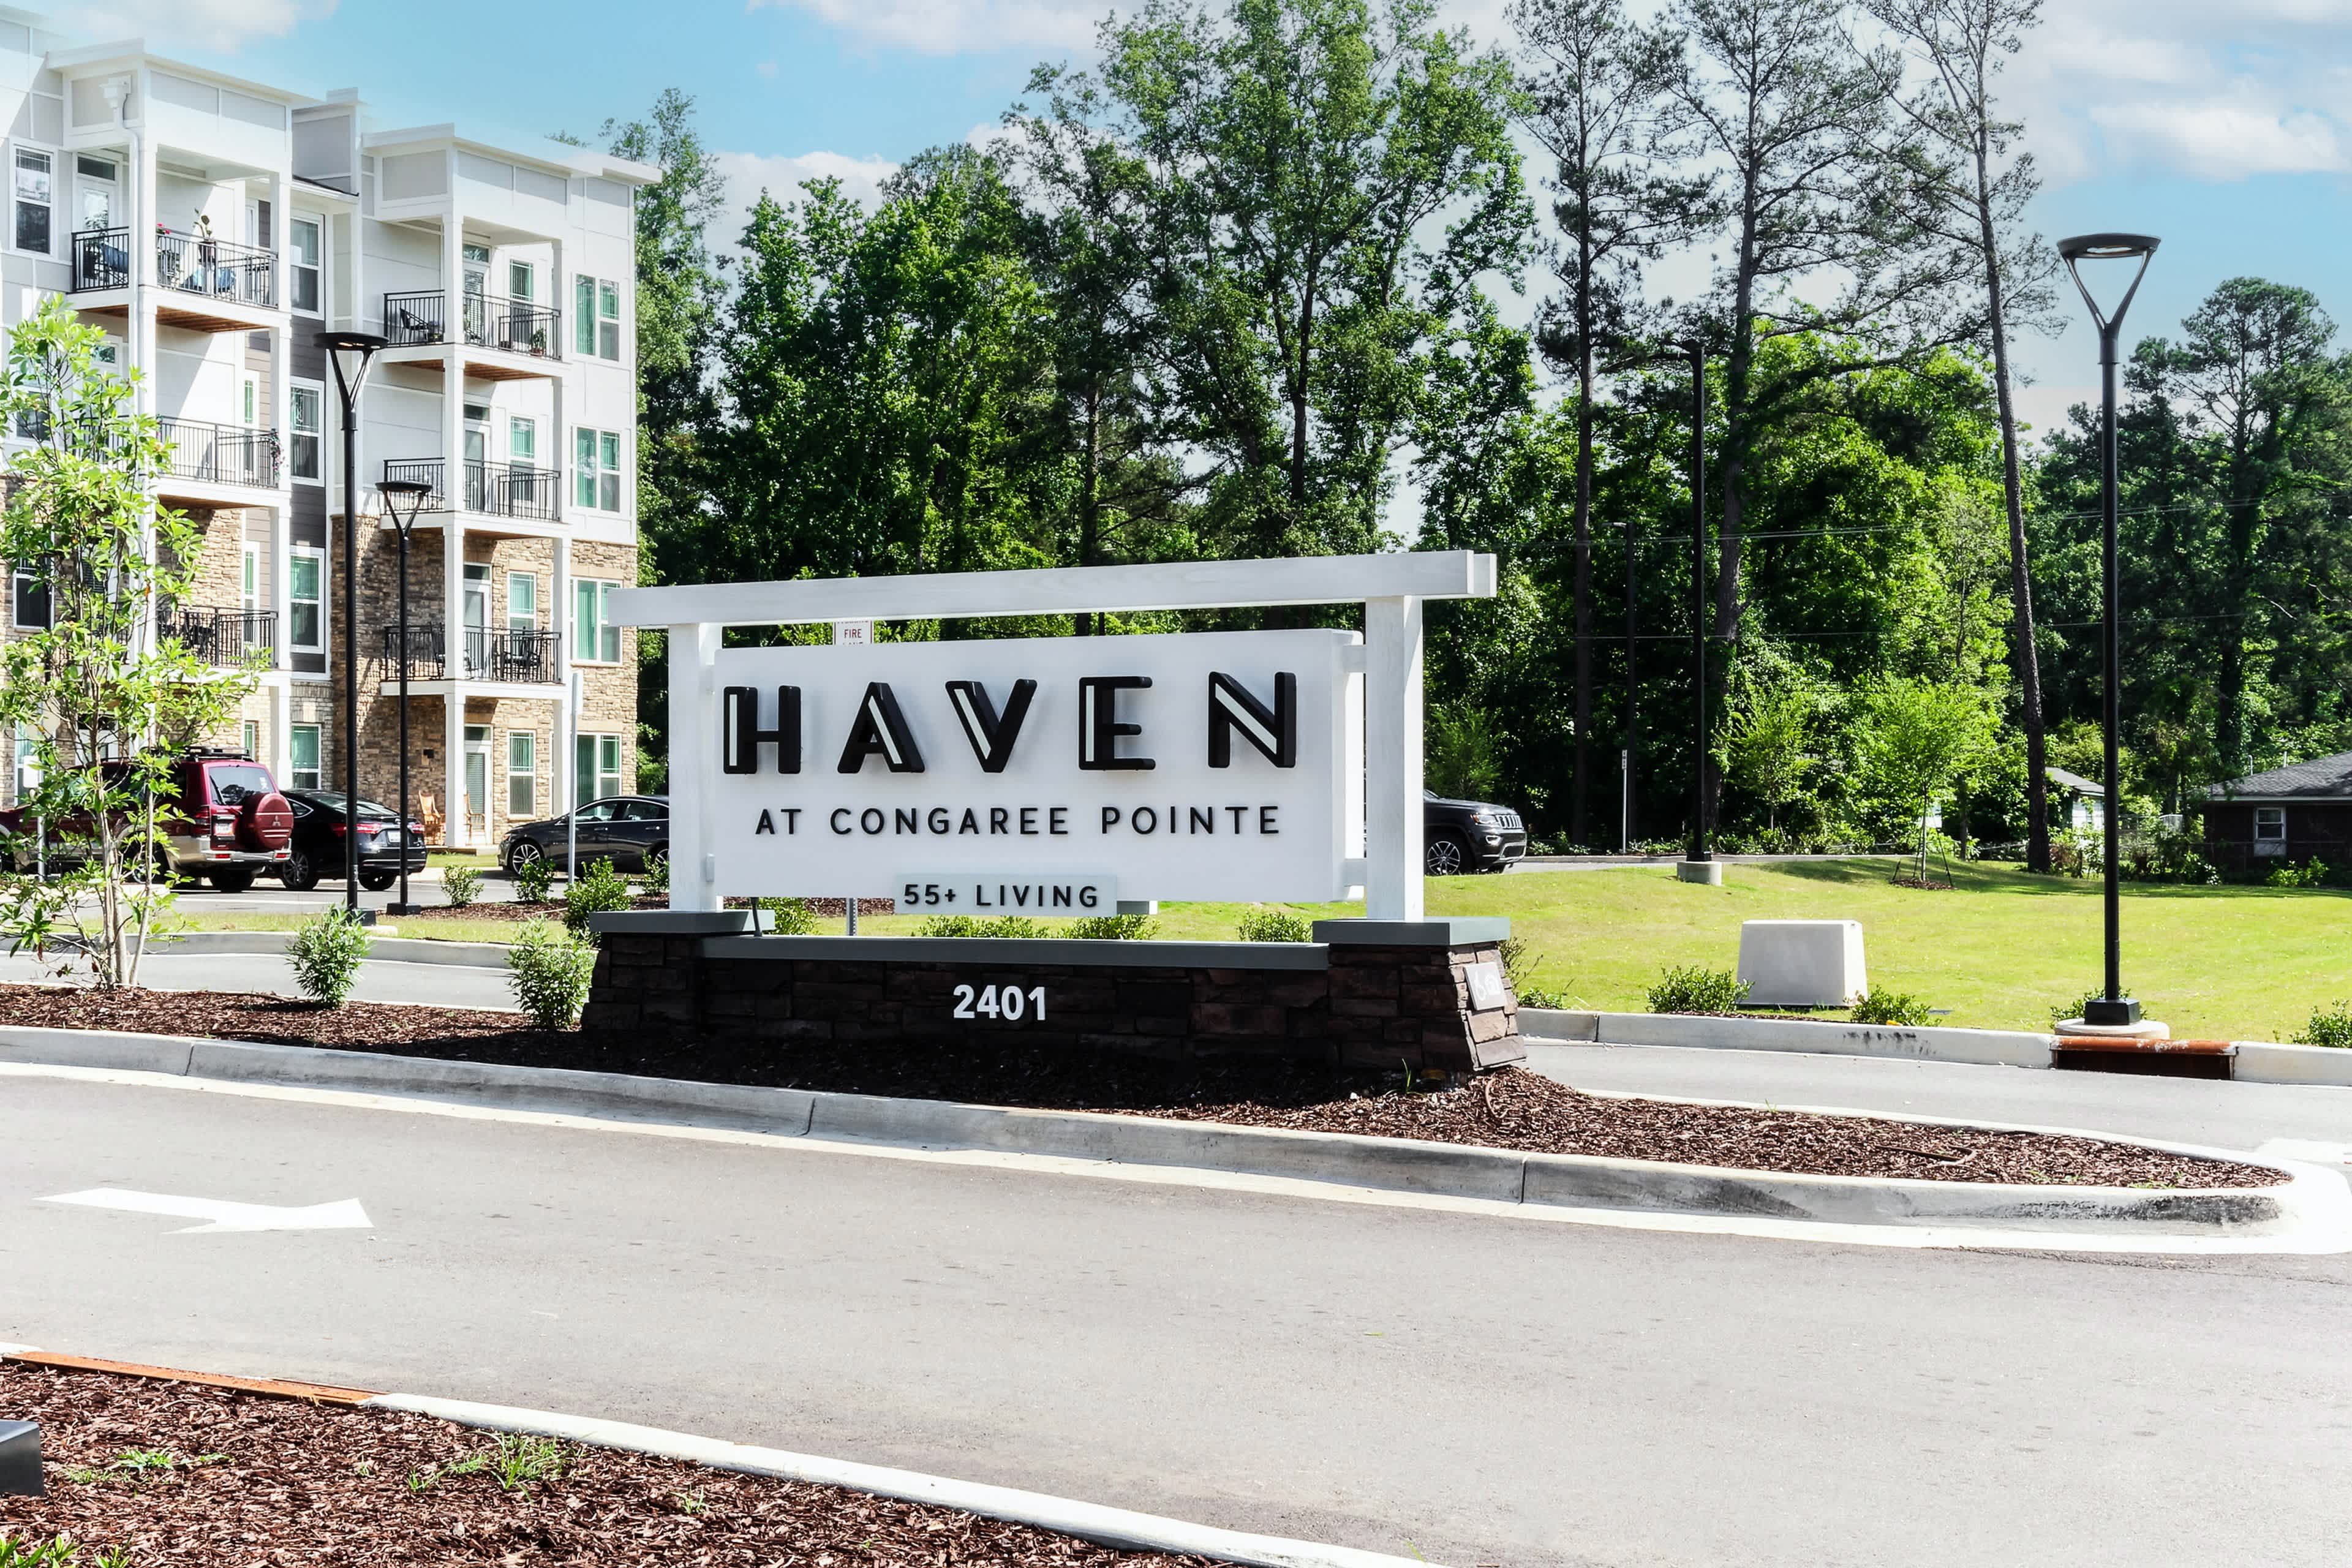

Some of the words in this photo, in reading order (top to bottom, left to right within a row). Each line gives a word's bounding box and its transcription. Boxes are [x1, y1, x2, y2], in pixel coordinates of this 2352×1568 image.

[844, 628, 862, 639] FIRE
[723, 671, 1297, 775] HAVEN
[755, 809, 802, 835] AT
[830, 807, 1069, 835] CONGAREE
[1101, 805, 1280, 835] POINTE
[904, 884, 956, 906] 55+
[976, 884, 1098, 908] LIVING
[953, 984, 1046, 1020] 2401
